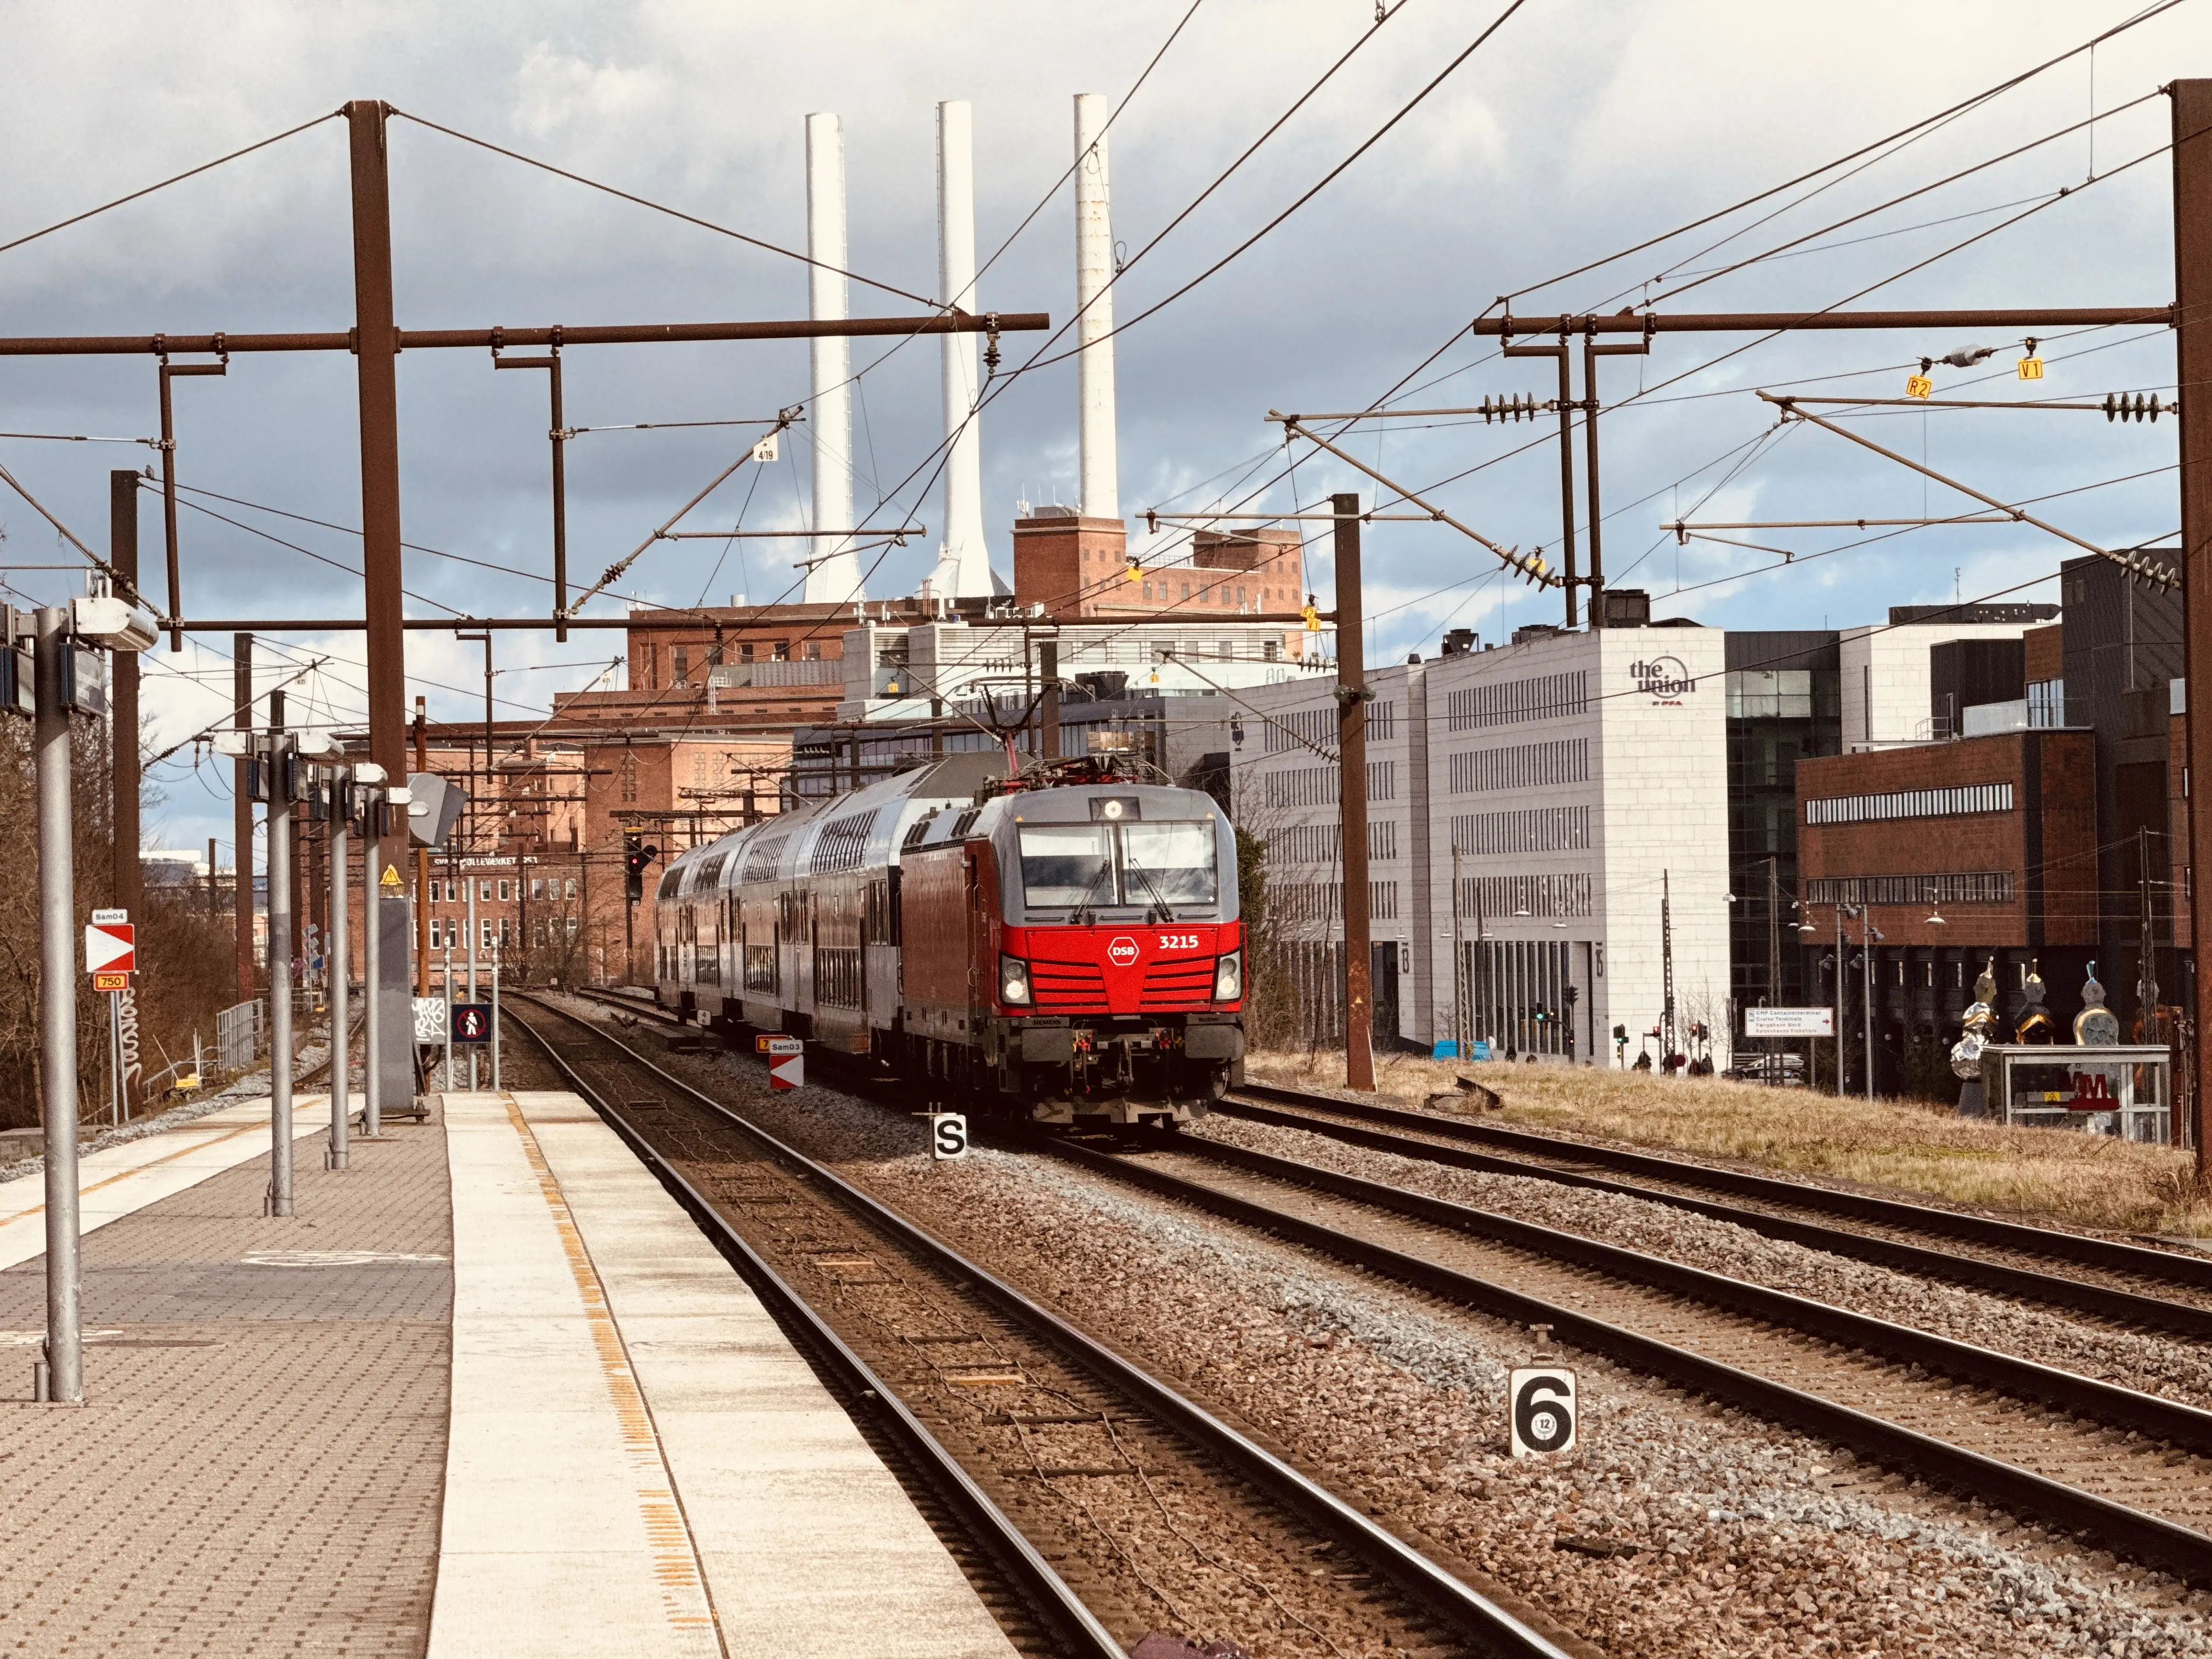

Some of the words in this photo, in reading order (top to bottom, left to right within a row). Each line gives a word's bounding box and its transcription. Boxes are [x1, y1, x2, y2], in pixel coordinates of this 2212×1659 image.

[2022, 362, 2039, 377] V1
[1909, 379, 1928, 397] R2
[758, 450, 773, 460] 4/19
[1629, 659, 1663, 678] the
[1637, 674, 1696, 693] union
[1159, 935, 1199, 949] 3215
[1113, 946, 1135, 956] DSB
[101, 977, 121, 986] 750
[936, 1120, 965, 1155] S
[1515, 1375, 1572, 1452] 6
[1539, 1419, 1550, 1429] 12
